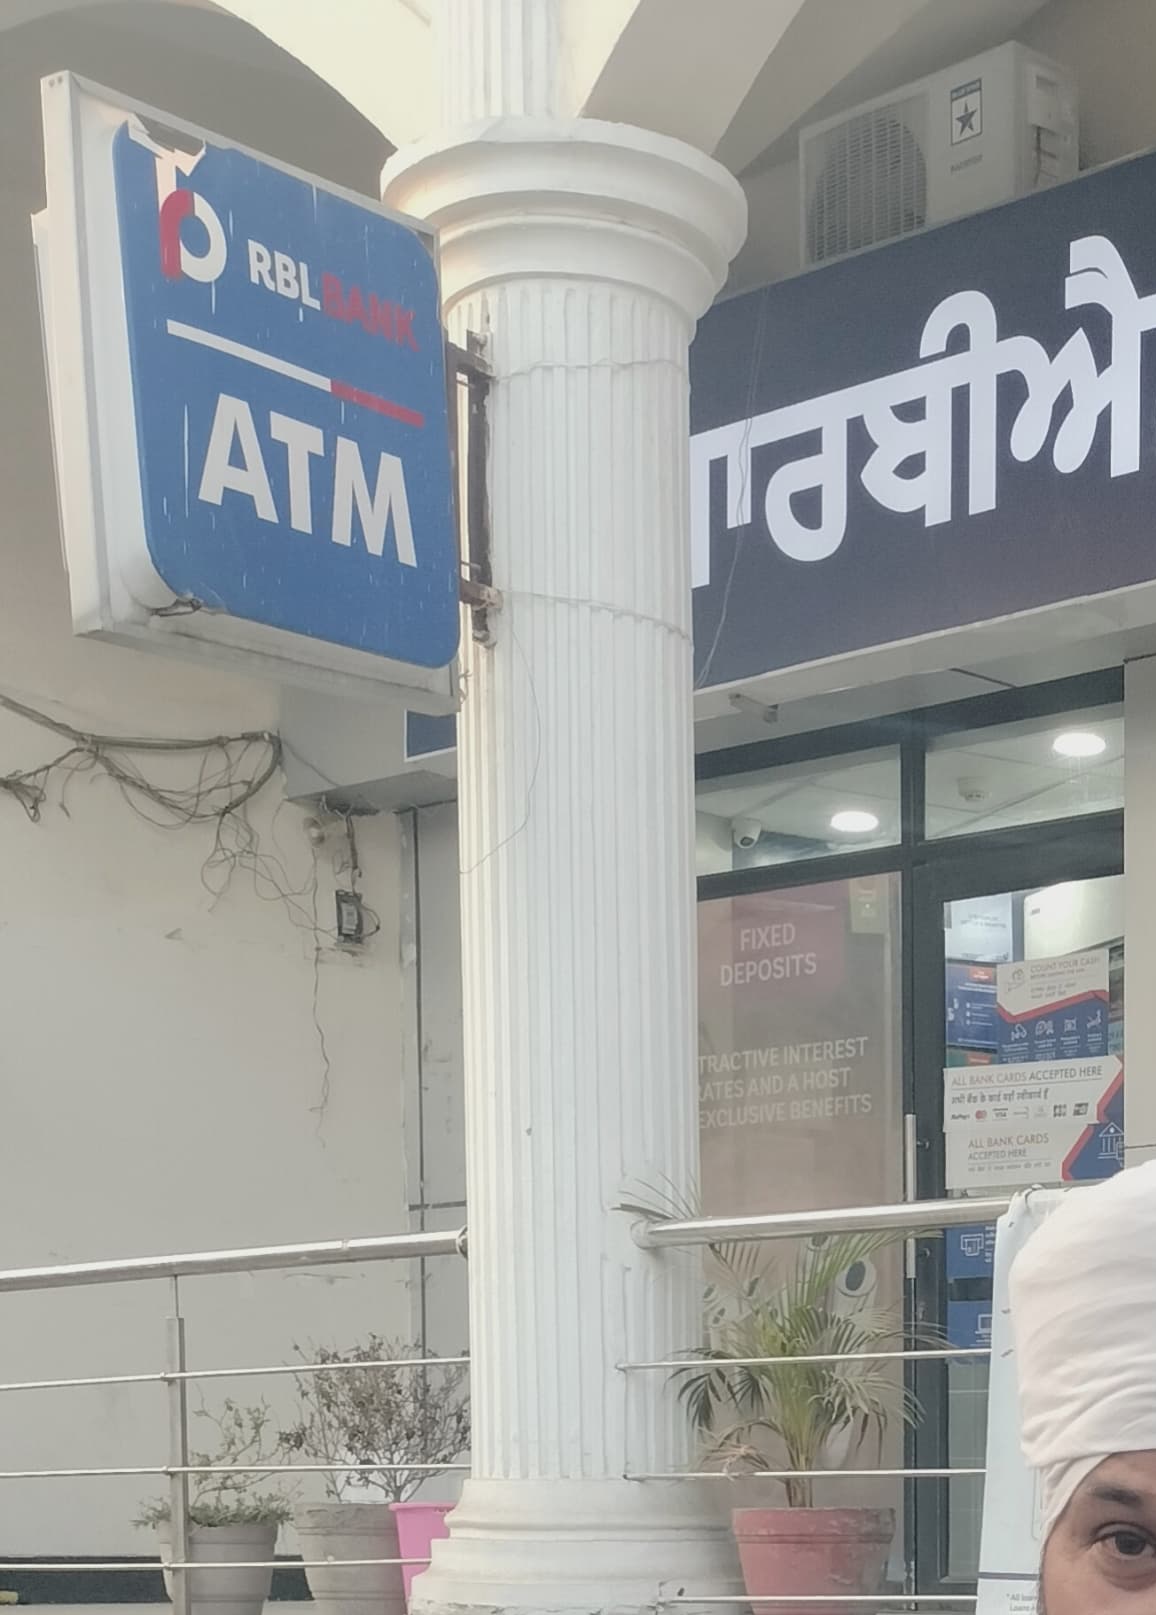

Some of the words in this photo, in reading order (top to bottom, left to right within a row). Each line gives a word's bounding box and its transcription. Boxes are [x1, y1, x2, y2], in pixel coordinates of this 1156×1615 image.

[198, 393, 417, 568] ATM
[740, 922, 796, 951] FIXED
[719, 952, 817, 986] DEPOSITS
[697, 1049, 779, 1074] TRACTIVE
[783, 1036, 868, 1065] INTEREST
[697, 1080, 744, 1102] ATES
[748, 1075, 783, 1097] AND
[787, 1074, 800, 1093] A
[803, 1067, 851, 1091] HOST
[952, 1076, 967, 1087] ALL
[970, 1074, 995, 1086] BANK
[997, 1072, 1027, 1085] CARDS
[1029, 1067, 1078, 1081] ACCEPTED
[1079, 1065, 1103, 1076] HERE
[790, 1093, 872, 1121] BENEFITS
[968, 1139, 984, 1149] ALL
[987, 1137, 1013, 1148] BANK
[1016, 1133, 1049, 1146] CARDS
[968, 1150, 1006, 1160] ACCEPTED
[1008, 1149, 1027, 1158] HERE
